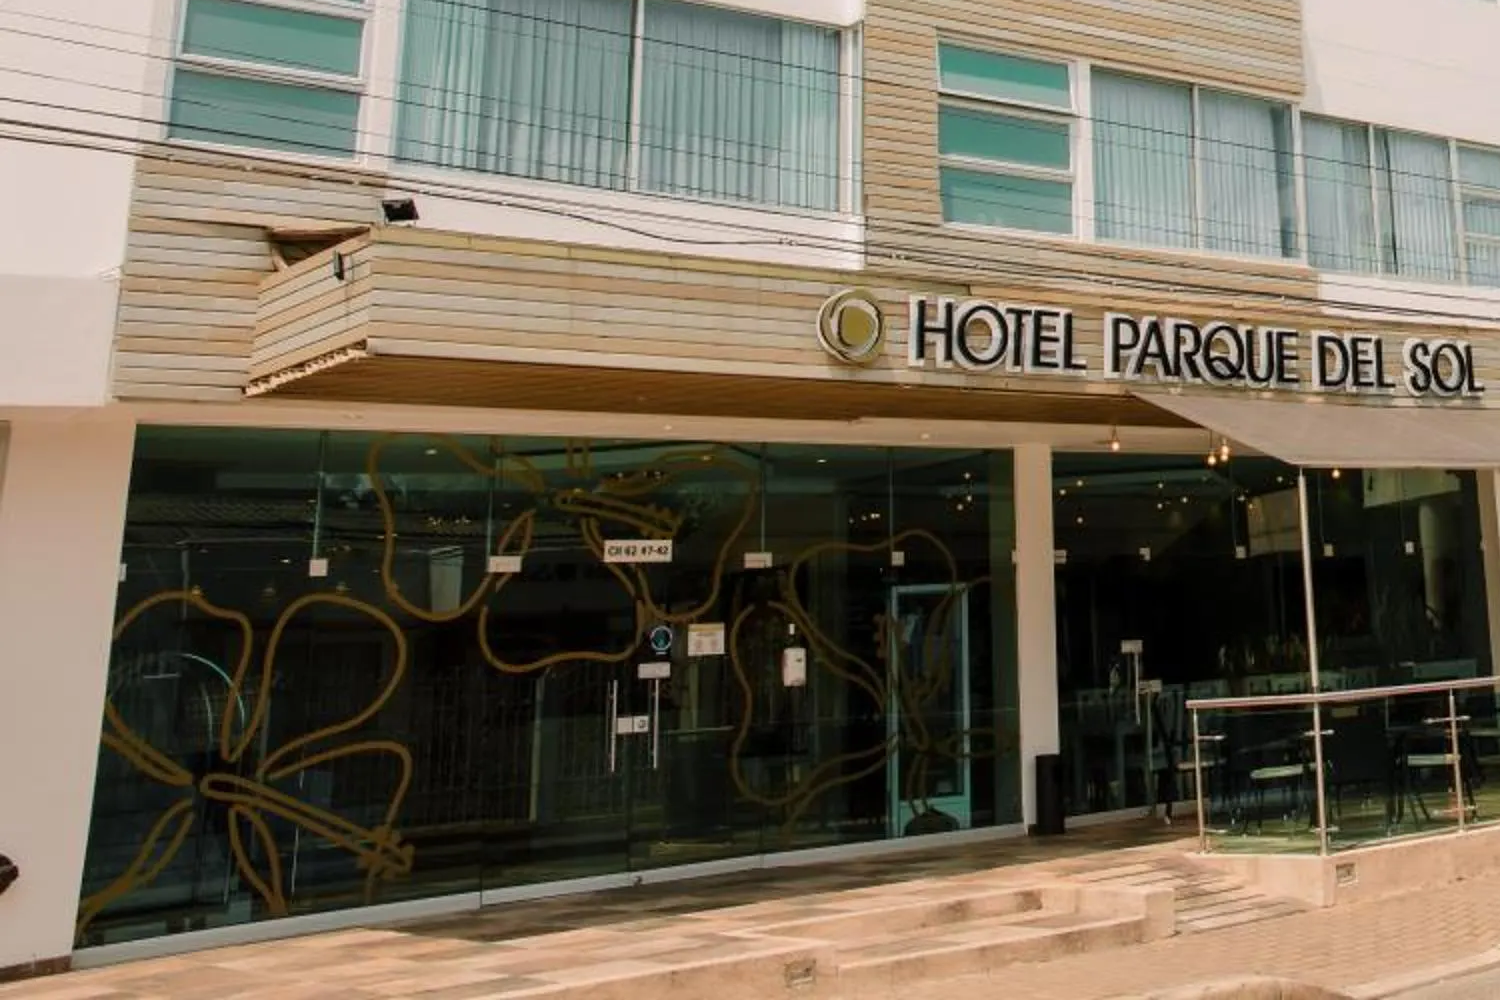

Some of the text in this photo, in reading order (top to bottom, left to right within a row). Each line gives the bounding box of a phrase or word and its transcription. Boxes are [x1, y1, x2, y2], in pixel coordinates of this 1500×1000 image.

[909, 295, 1485, 397] HOTEL PARQUE DEL SOL
